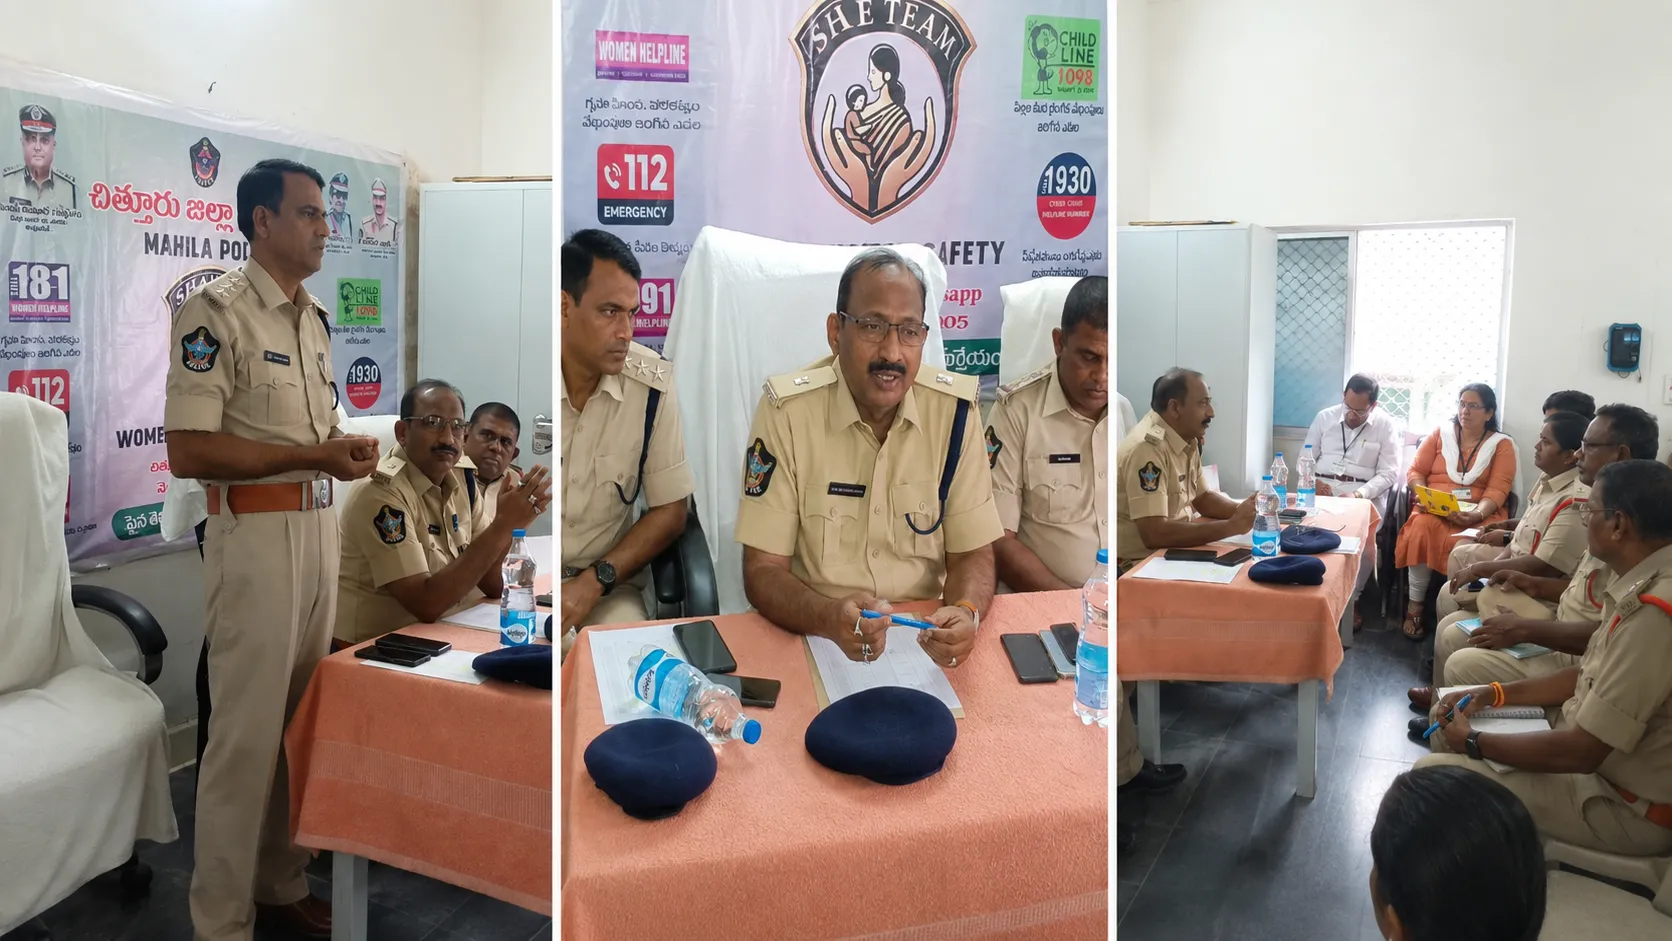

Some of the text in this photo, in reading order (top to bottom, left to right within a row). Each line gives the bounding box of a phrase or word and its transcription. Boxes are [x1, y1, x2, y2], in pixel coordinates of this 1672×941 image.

[884, 0, 957, 60] TEAM
[1060, 31, 1096, 47] CHILD
[598, 40, 686, 65] WOMEN HELPLINE
[1061, 48, 1094, 64] LINE
[1058, 67, 1093, 86] 1098
[624, 154, 668, 191] 112
[1045, 166, 1091, 194] 1930
[88, 182, 181, 225] చిత్తూరు
[186, 199, 234, 233] జిల్లా
[604, 206, 668, 219] EMERGENCY
[144, 232, 213, 259] MAHILA
[924, 241, 1005, 265] AFETY
[634, 282, 672, 315] 91
[350, 365, 379, 383] 1930
[32, 376, 65, 405] 112
[116, 426, 166, 449] WOME
